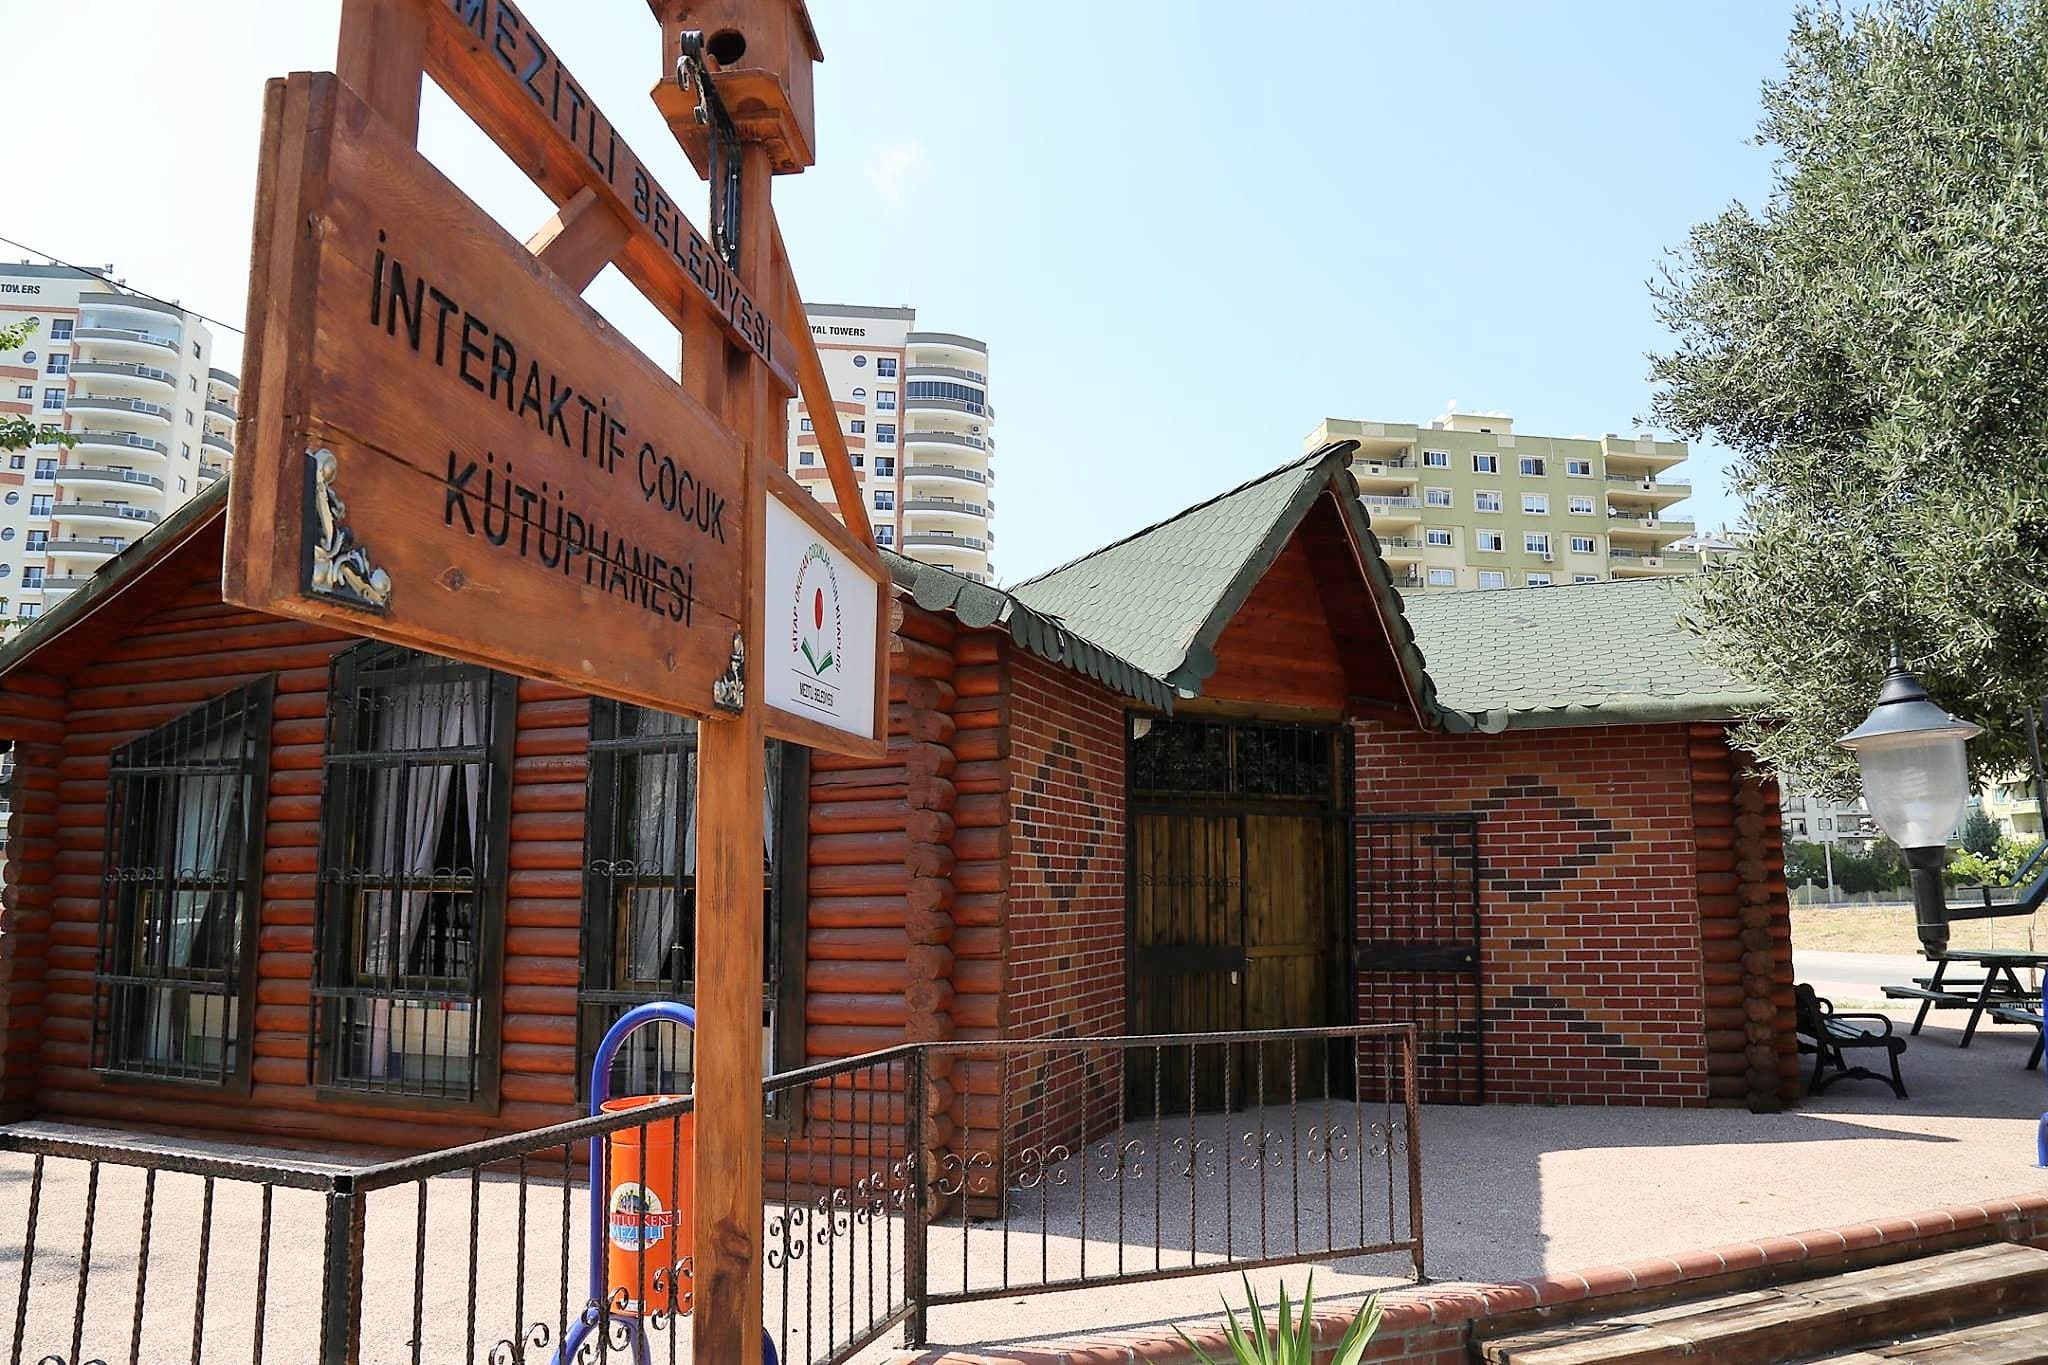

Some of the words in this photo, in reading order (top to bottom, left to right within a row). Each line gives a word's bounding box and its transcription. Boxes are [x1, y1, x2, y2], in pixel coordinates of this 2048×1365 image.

[1, 283, 41, 295] TOWERS
[634, 166, 773, 362] BELEDİYESİ
[829, 326, 866, 337] TOWERS
[369, 228, 627, 474] İNTERAKTİF
[638, 441, 726, 545] ÇOCUK
[443, 449, 694, 628] KÜTÜPHANESİ
